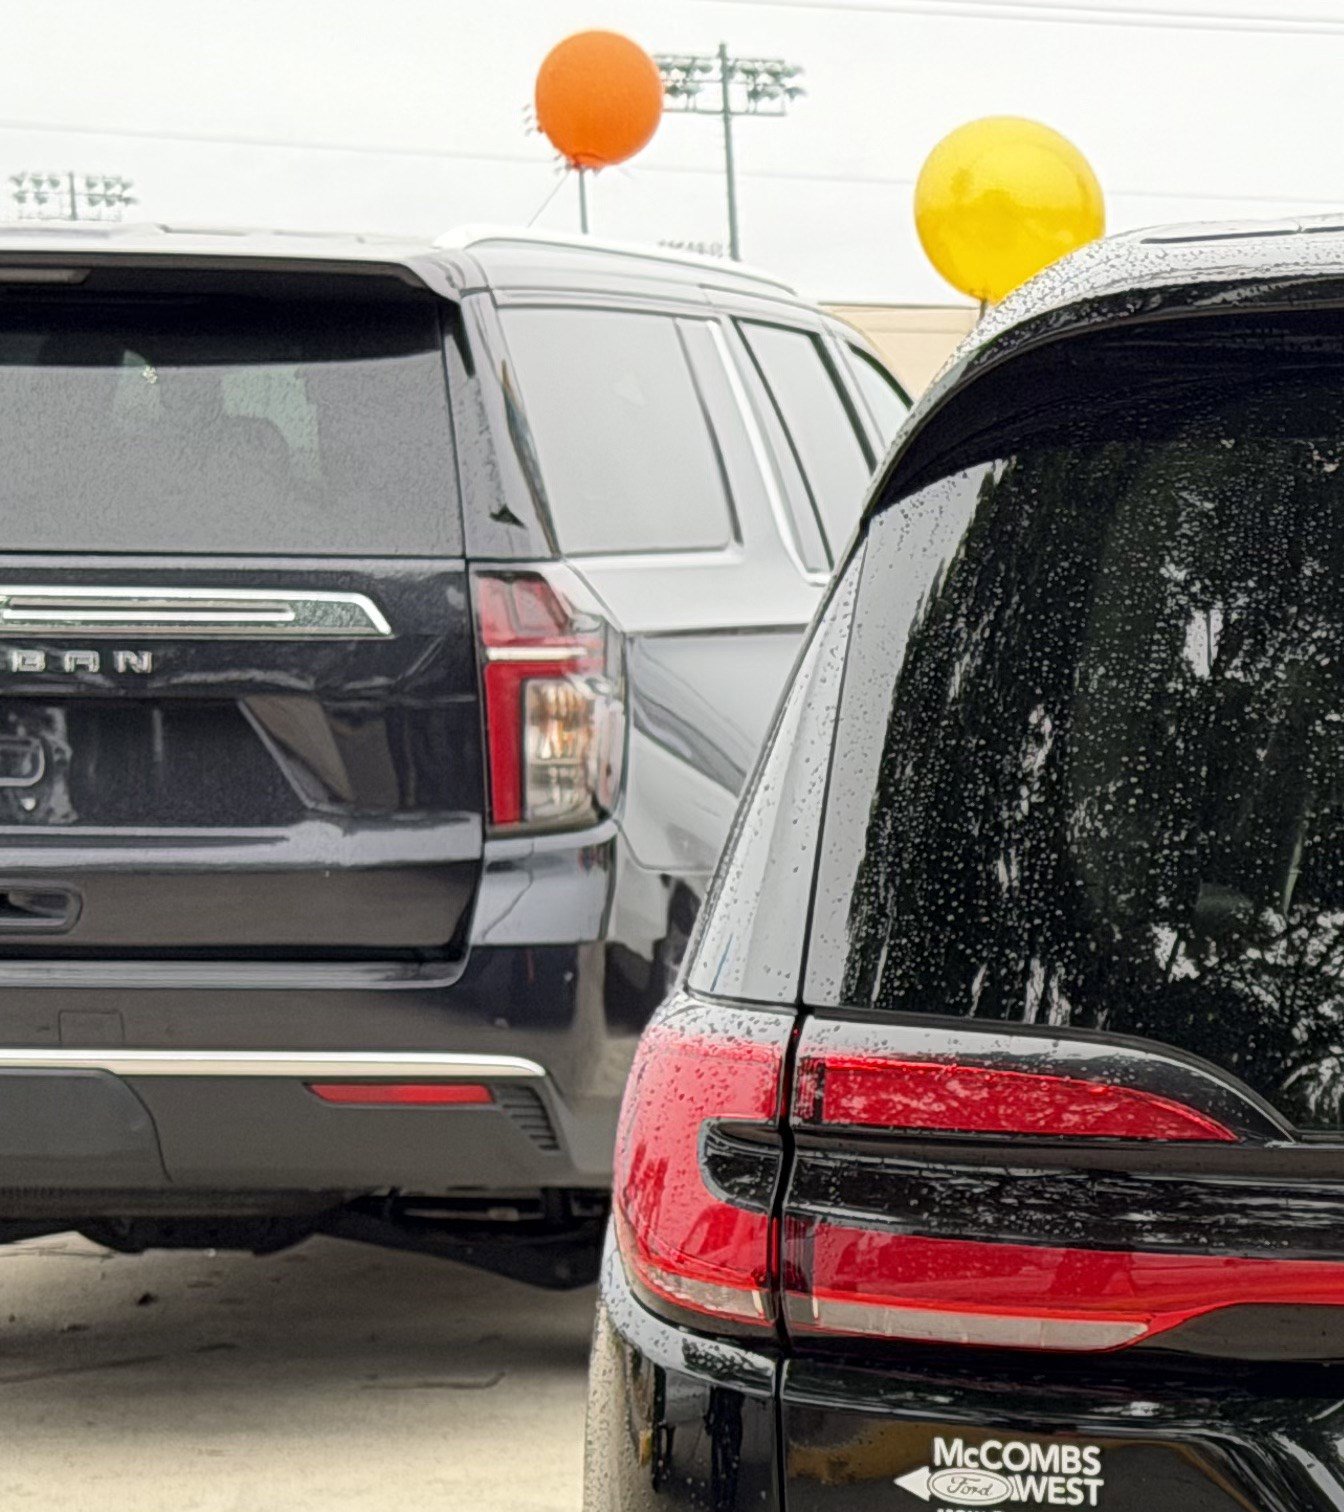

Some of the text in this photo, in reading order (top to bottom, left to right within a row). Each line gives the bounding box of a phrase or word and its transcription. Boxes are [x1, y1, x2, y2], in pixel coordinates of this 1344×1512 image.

[933, 1436, 1102, 1477] McCOMBS
[946, 1476, 994, 1497] Ford
[1018, 1474, 1104, 1507] WEST
